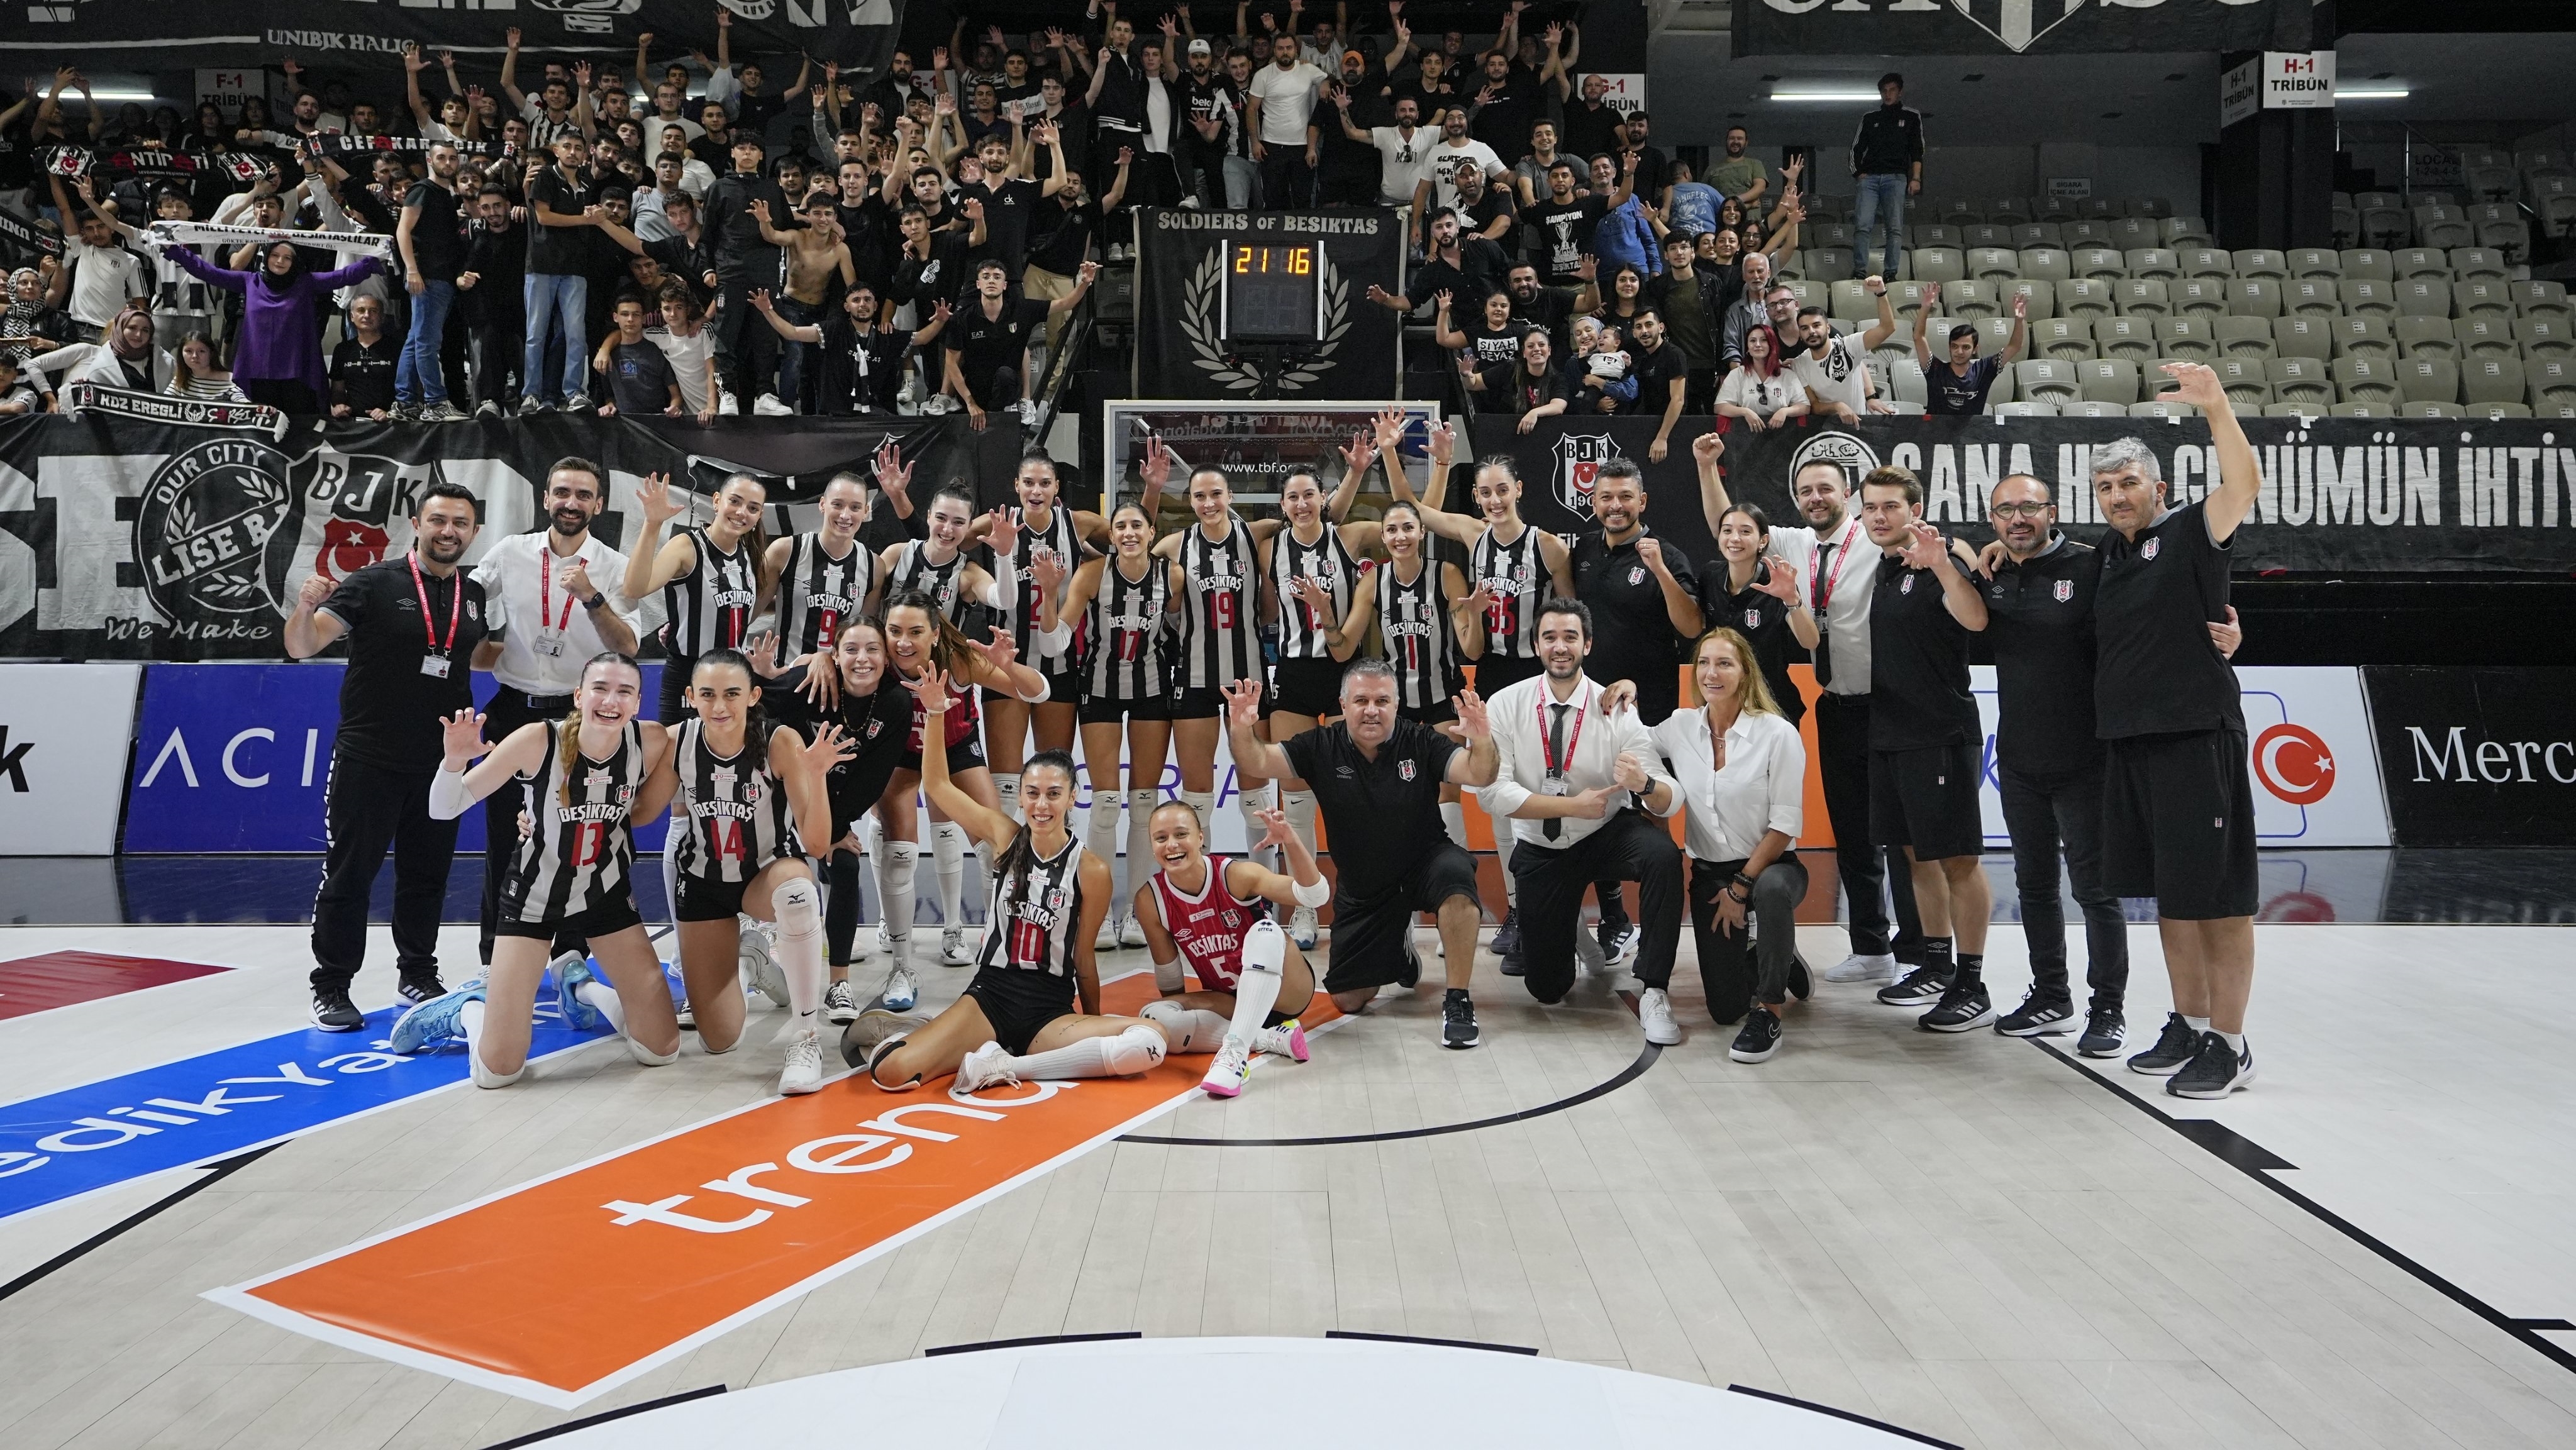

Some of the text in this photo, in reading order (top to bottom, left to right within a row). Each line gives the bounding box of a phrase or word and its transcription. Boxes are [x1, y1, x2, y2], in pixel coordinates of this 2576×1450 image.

[2285, 58, 2314, 73] H-1
[216, 73, 242, 89] F-1
[2271, 77, 2328, 91] TRİBÜN
[202, 92, 250, 106] TRİBÜ
[1192, 96, 1212, 107] bek
[1603, 97, 1638, 111] İBÜN
[1158, 212, 1248, 230] SOLDIERS
[1284, 215, 1378, 235] BESIKTAS
[1546, 210, 1583, 225] ŞAMPİYON
[1236, 247, 1309, 274] 21 16
[101, 394, 128, 410] KDZ
[1566, 443, 1607, 458] BJK
[157, 444, 266, 504] OUR CITY
[1892, 443, 2035, 523] SANA
[152, 525, 241, 586] LISE
[1197, 573, 1243, 592] BEŞİKTAŞ
[713, 587, 755, 609] BEŞİKTAŞ
[806, 591, 853, 615] BEŞİKTAŞ
[1108, 612, 1153, 632] BEŞİKTAŞ
[1210, 592, 1235, 629] 19
[106, 616, 272, 640] We Make
[819, 608, 837, 647] 9
[1387, 619, 1433, 639] BEŞİKTAŞ
[1119, 631, 1141, 661] 17
[1407, 634, 1416, 670] 1
[140, 726, 318, 787] ACI
[558, 801, 625, 823] BEŞİKTAŞ
[692, 797, 756, 822] BEŞİKTAŞ
[570, 822, 605, 867] 13
[709, 819, 747, 862] 14
[1010, 917, 1045, 964] 10
[1209, 955, 1240, 990] 5
